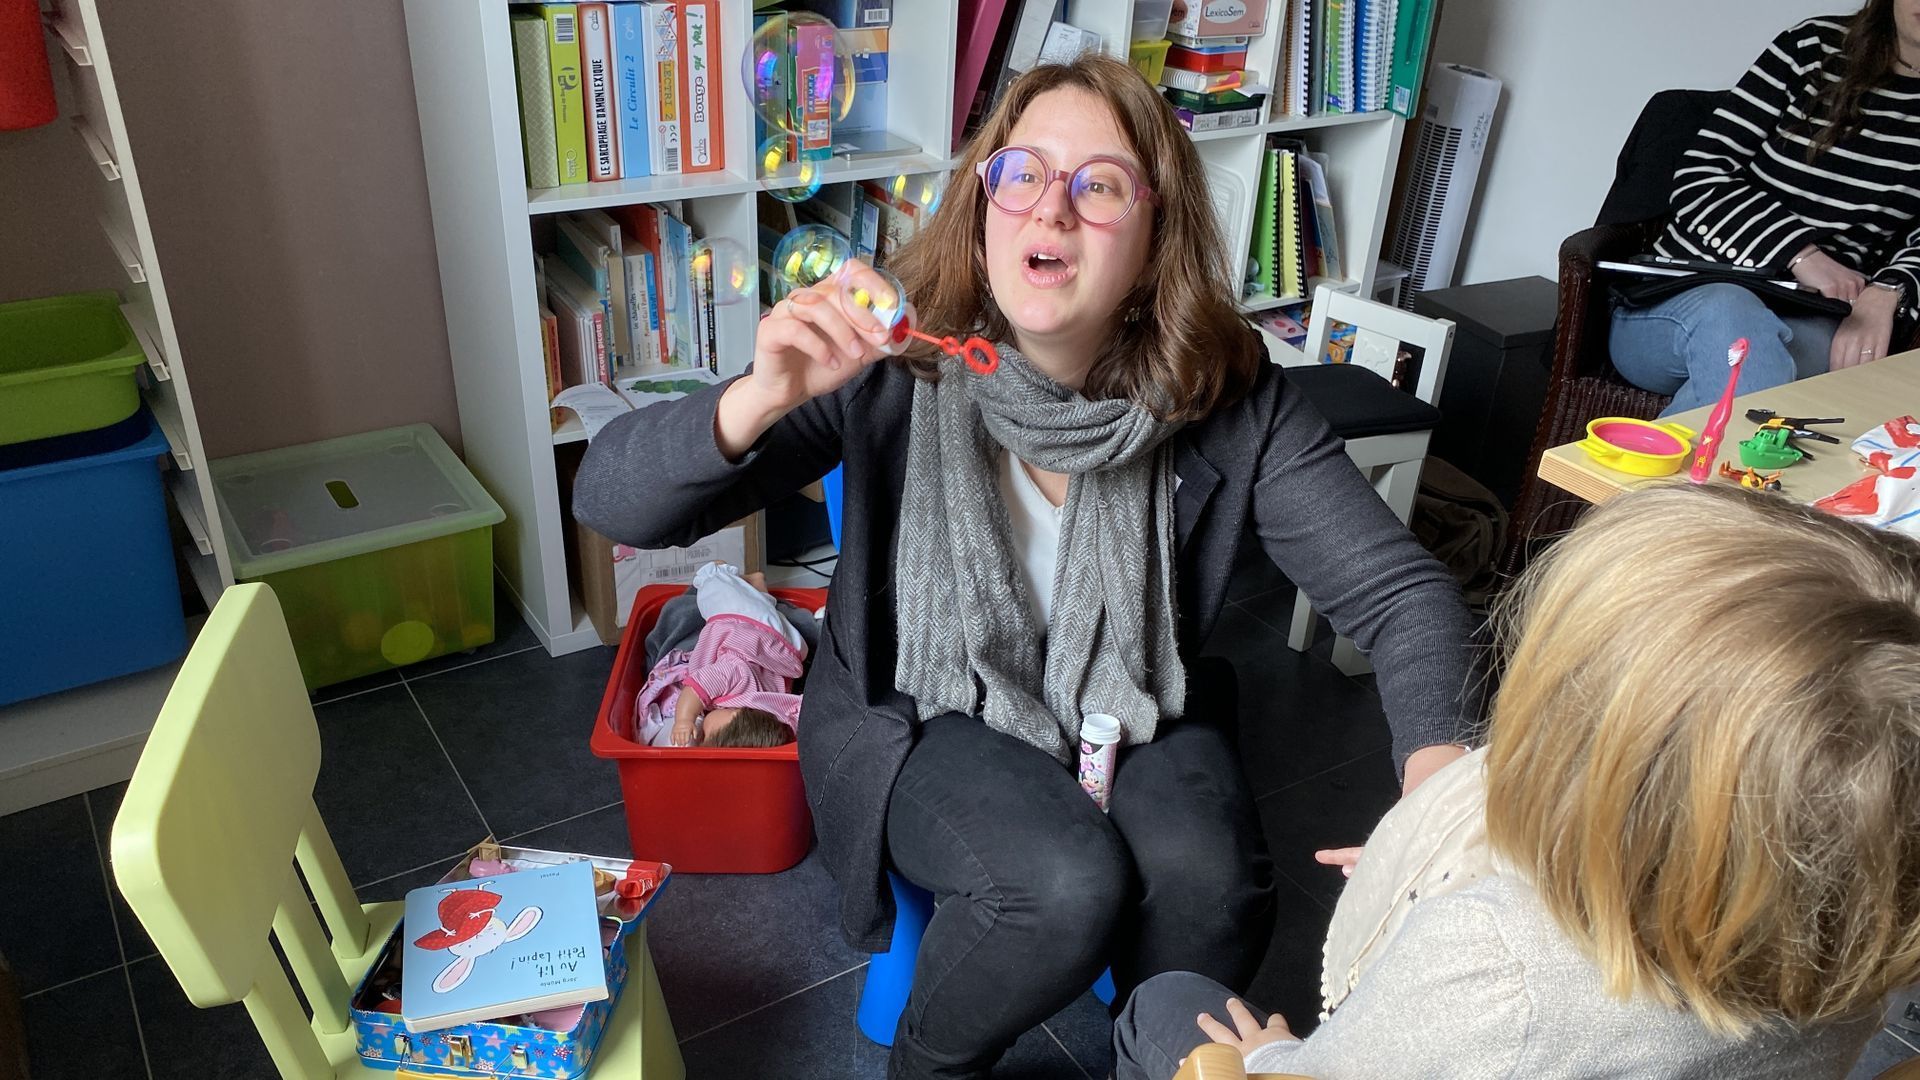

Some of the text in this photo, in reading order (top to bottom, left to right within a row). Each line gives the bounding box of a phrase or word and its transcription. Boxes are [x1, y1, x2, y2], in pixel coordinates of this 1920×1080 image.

[1205, 6, 1245, 17] LexicoSem
[590, 10, 600, 32] Ortho
[625, 68, 638, 112] Circulit
[695, 76, 706, 123] Bouge
[629, 117, 639, 130] Le
[597, 120, 610, 167] SARCOPHAGE
[695, 138, 708, 164] Ortho
[601, 166, 611, 176] LE
[558, 946, 586, 959] Petit
[560, 960, 578, 972] Au
